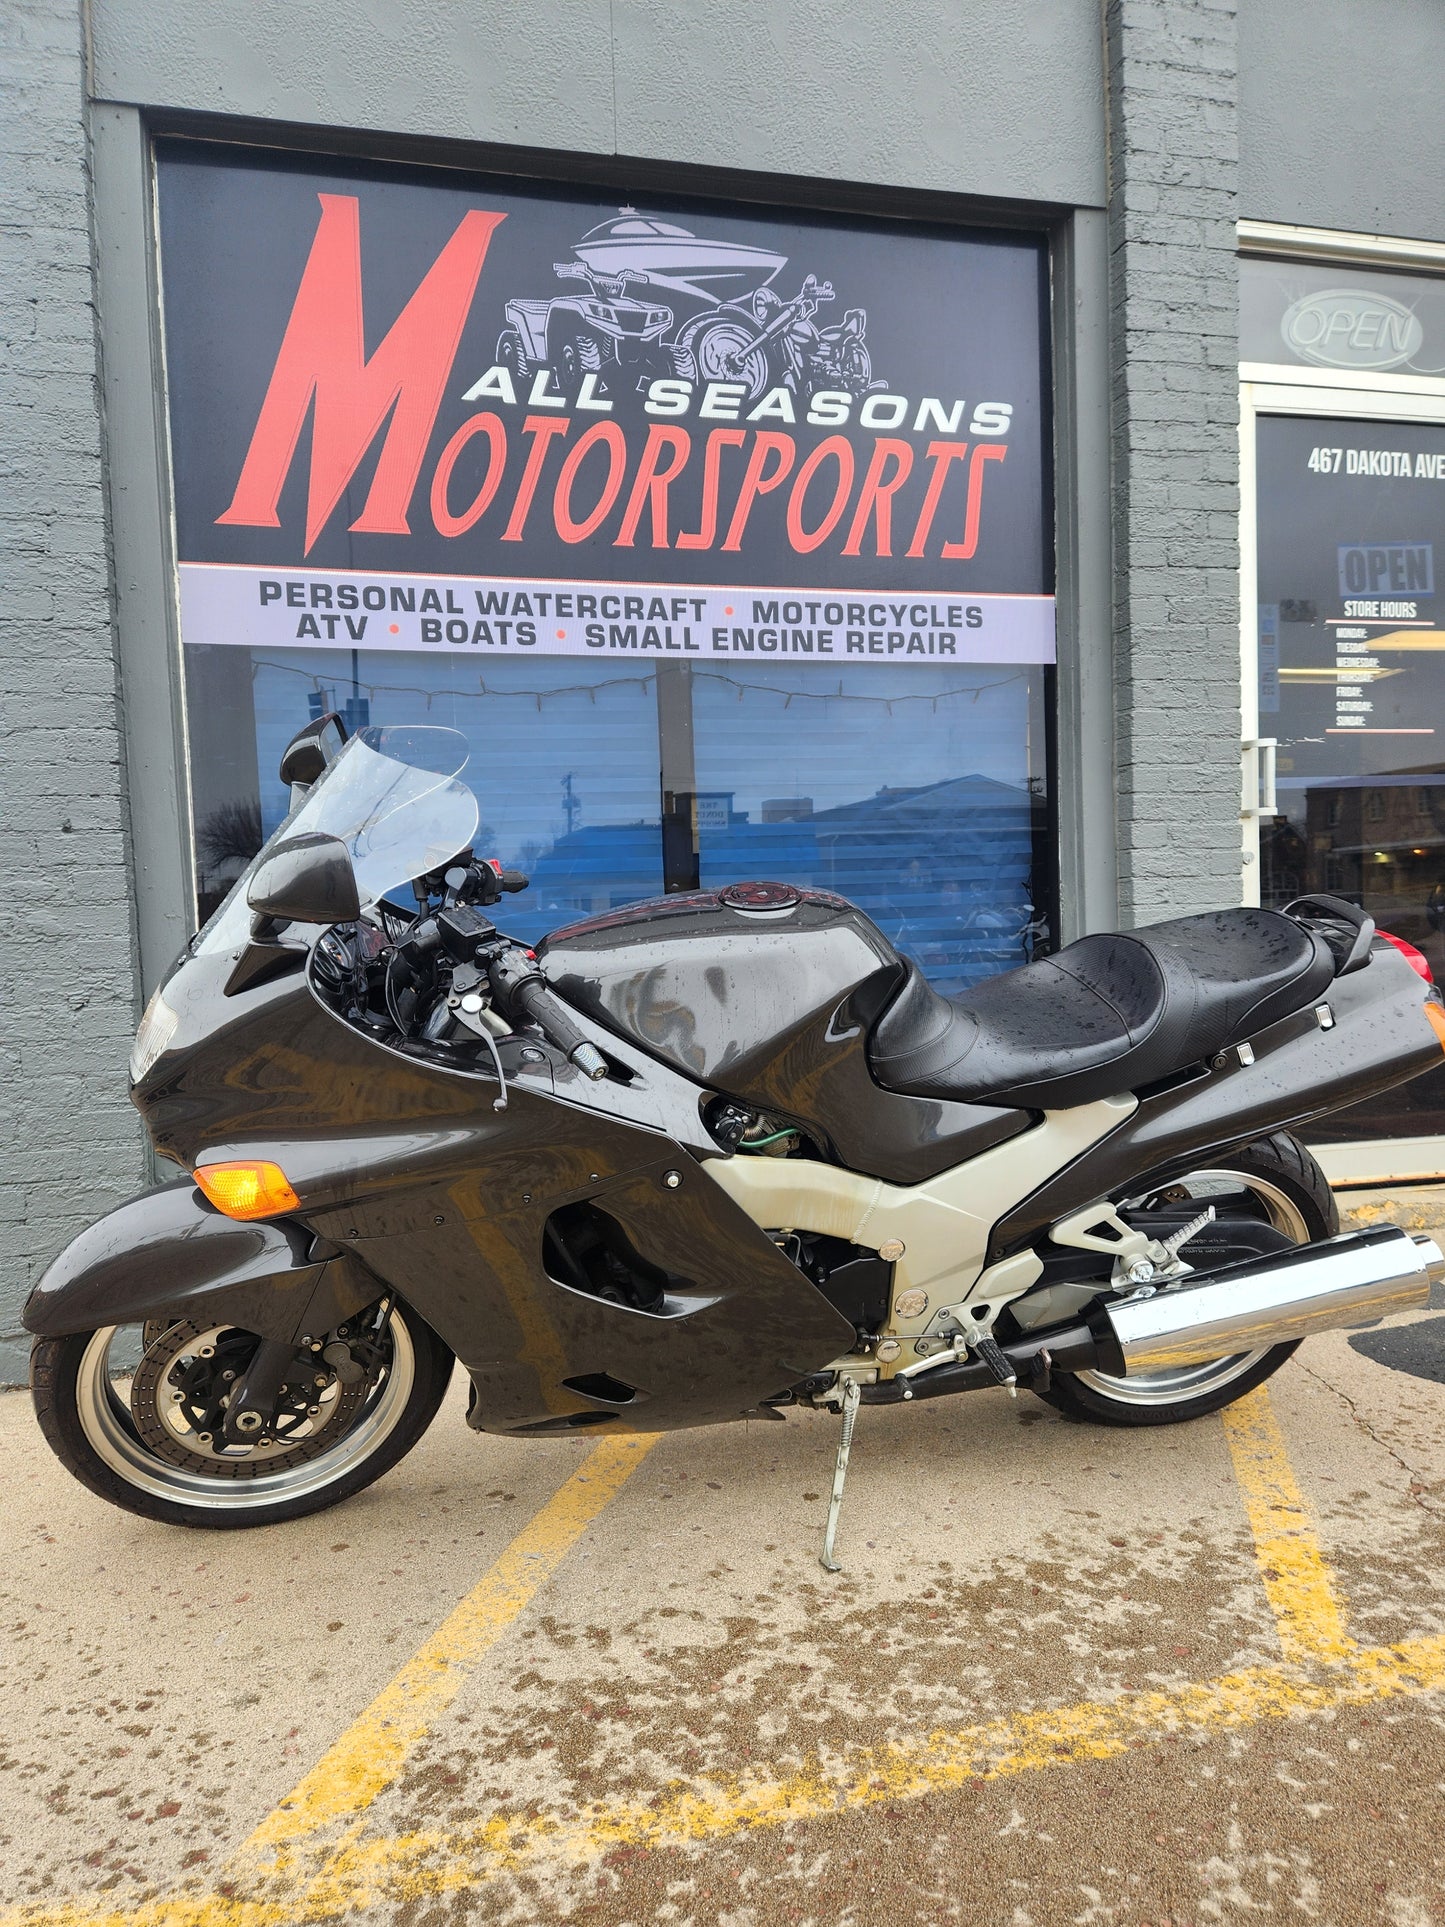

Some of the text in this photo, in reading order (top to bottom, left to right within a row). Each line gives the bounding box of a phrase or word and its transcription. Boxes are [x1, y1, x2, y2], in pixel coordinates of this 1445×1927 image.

[1289, 307, 1413, 352] OPEN
[214, 193, 1008, 559] MOTORSPORTS
[461, 366, 1014, 436] ALL SEASONS
[1308, 447, 1343, 474] 467
[1346, 449, 1412, 478] DAKOTA
[1344, 548, 1428, 593] OPEN
[259, 580, 983, 628] PERSONAL WATERCRAFT MOTORCYCLES
[1344, 600, 1417, 618] STORE HOURS
[296, 613, 957, 655] ATV BOATS SMALL ENGINE REPAIR
